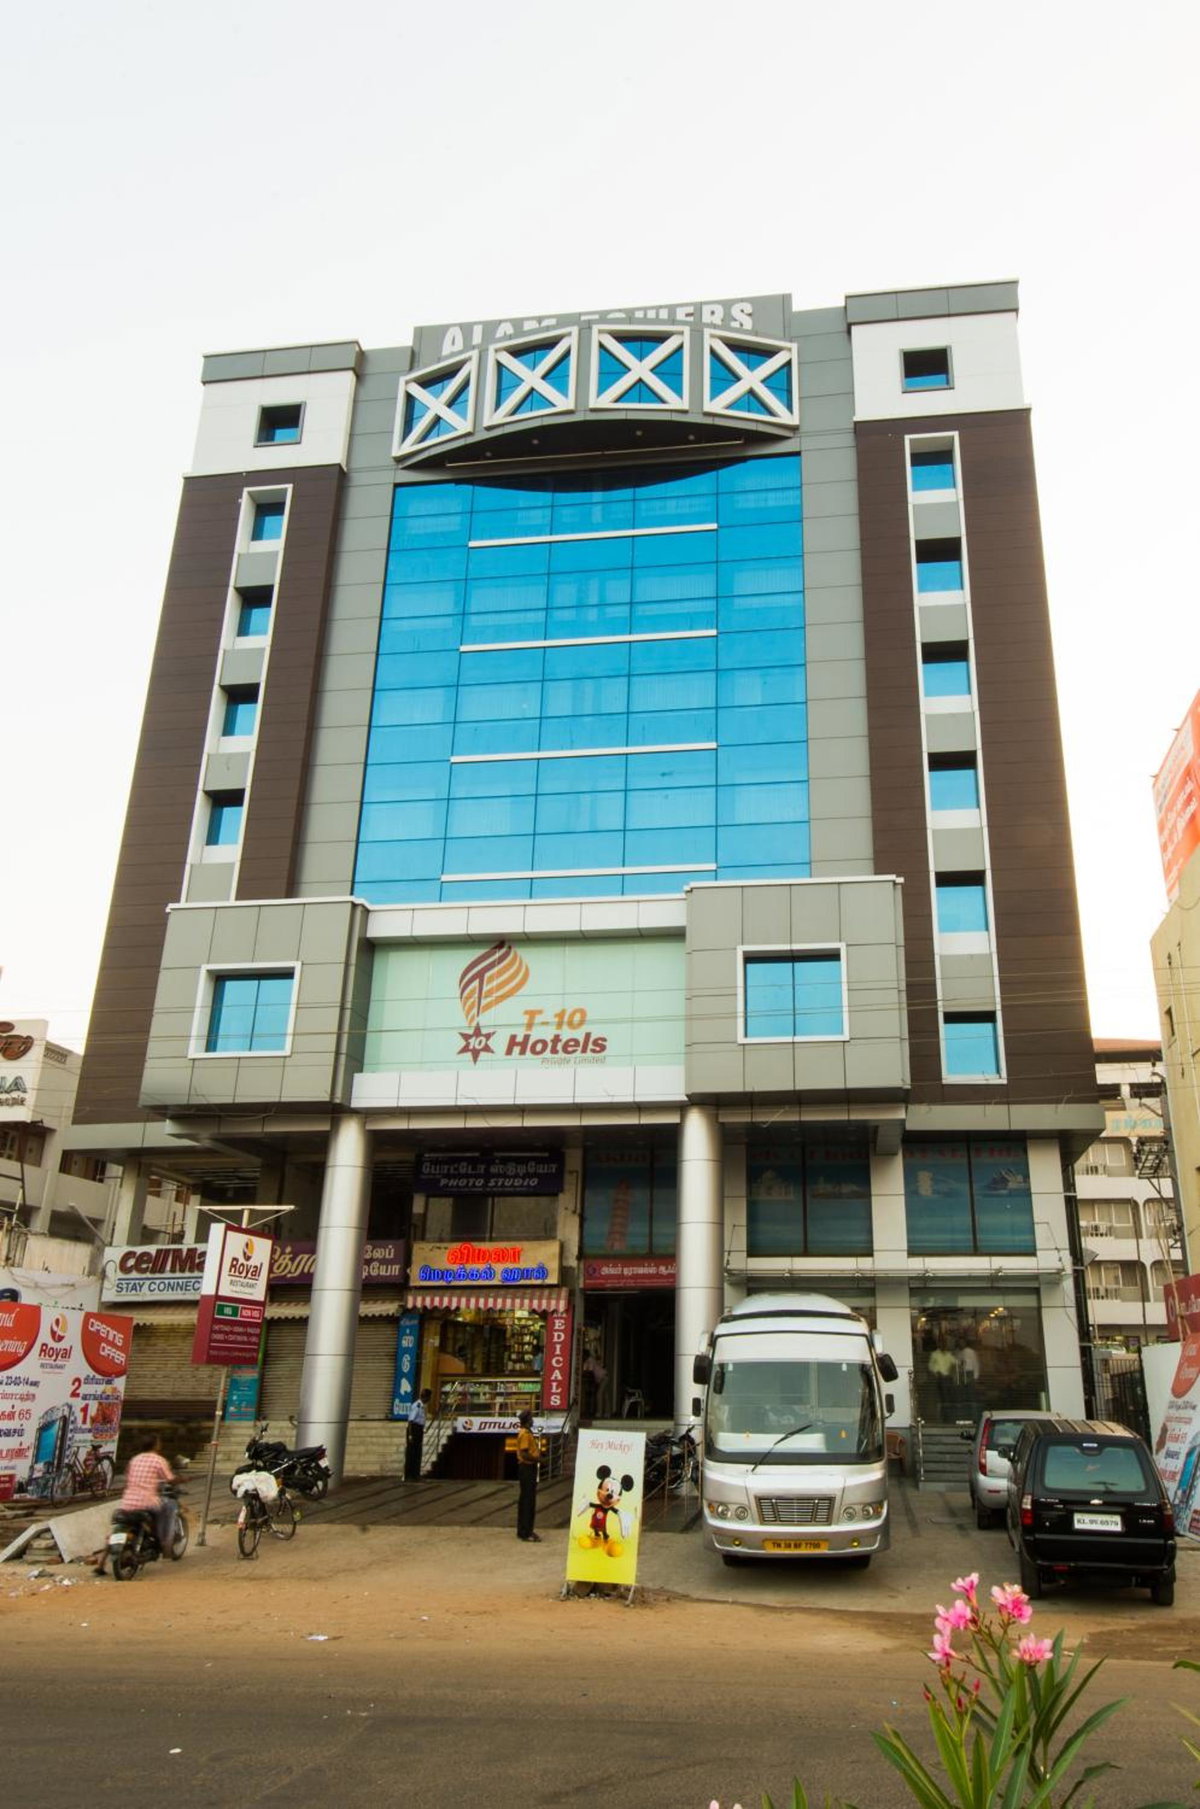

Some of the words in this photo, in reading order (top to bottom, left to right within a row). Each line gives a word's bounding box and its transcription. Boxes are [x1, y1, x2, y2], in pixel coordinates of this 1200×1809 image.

[580, 302, 753, 330] ERS
[523, 1007, 587, 1031] T-10
[505, 1032, 608, 1056] Hotels
[440, 1178, 484, 1188] PHOTO
[488, 1178, 540, 1188] STUDIO
[447, 1242, 522, 1264] விமலா
[229, 1257, 263, 1280] Royal
[116, 1281, 146, 1293] STAY
[148, 1280, 202, 1293] CONNEC
[229, 1279, 258, 1290] RESTAURANT
[89, 1318, 124, 1346] OPENING
[39, 1343, 73, 1362] Royal
[100, 1342, 126, 1366] OFFER
[70, 1377, 82, 1398] 2
[18, 1408, 32, 1421] 65
[80, 1403, 90, 1424] 1
